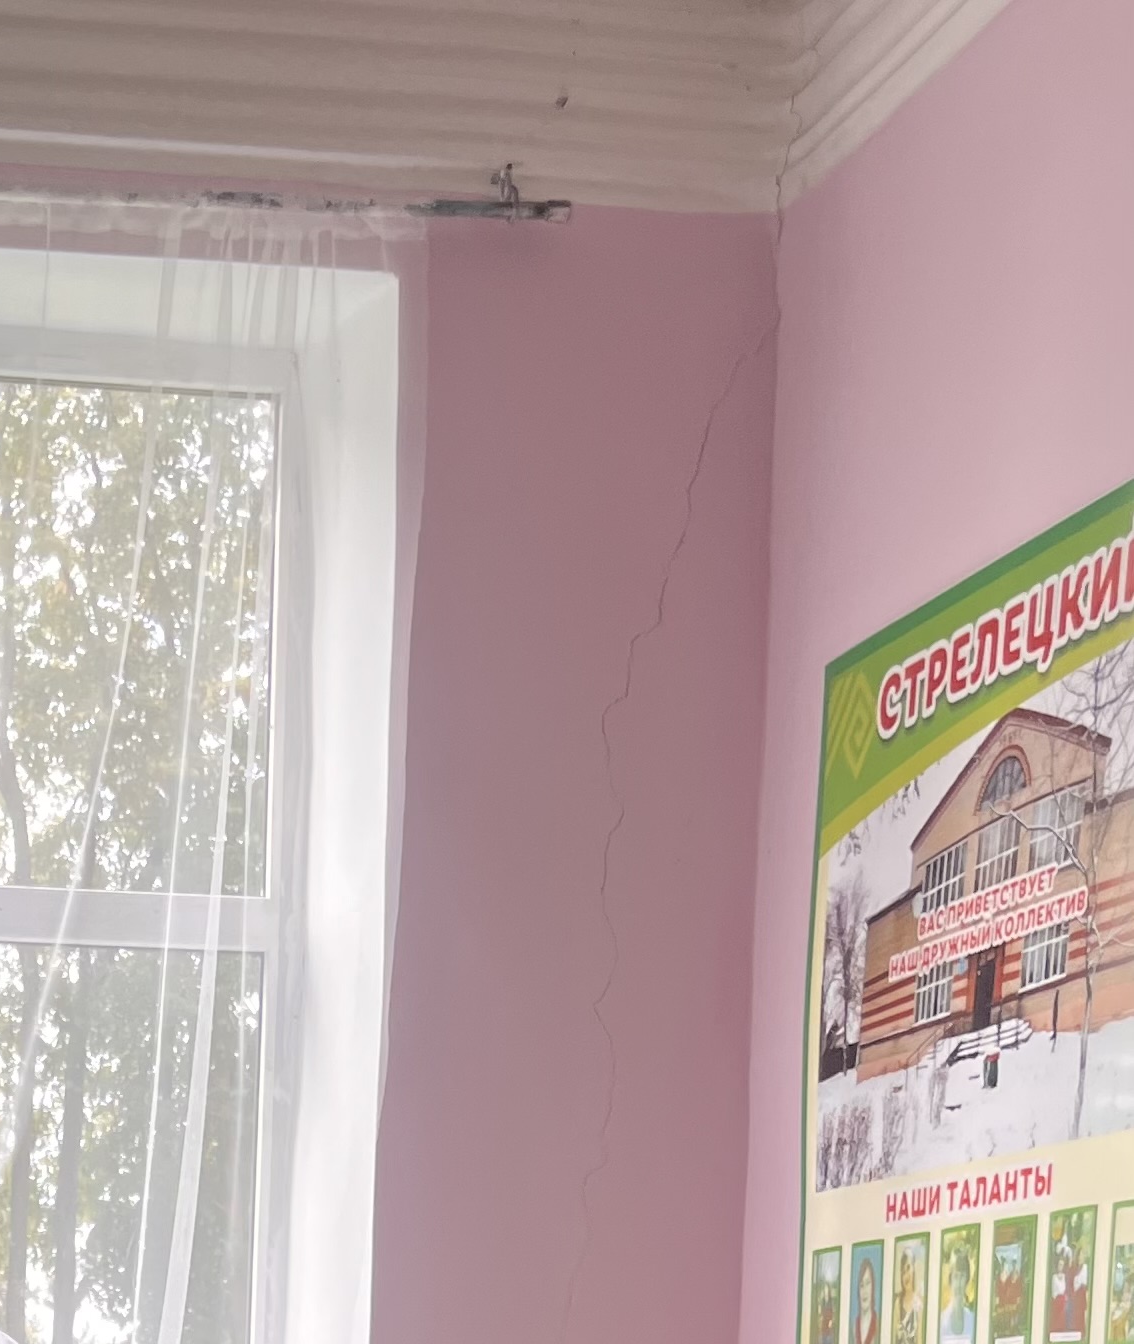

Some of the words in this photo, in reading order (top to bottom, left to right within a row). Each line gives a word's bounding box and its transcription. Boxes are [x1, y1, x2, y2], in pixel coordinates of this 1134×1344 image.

[891, 952, 918, 977] НАШ
[922, 922, 992, 968] ДРУЖНЫЙ
[995, 889, 1087, 941] КОЛЛЕКТИВ
[919, 909, 946, 936] ВАС
[947, 866, 1056, 924] ПРИВЕТСТВУЕТ
[886, 1184, 942, 1223] НАШИ
[947, 1163, 1053, 1212] ТАЛАНТЫ
